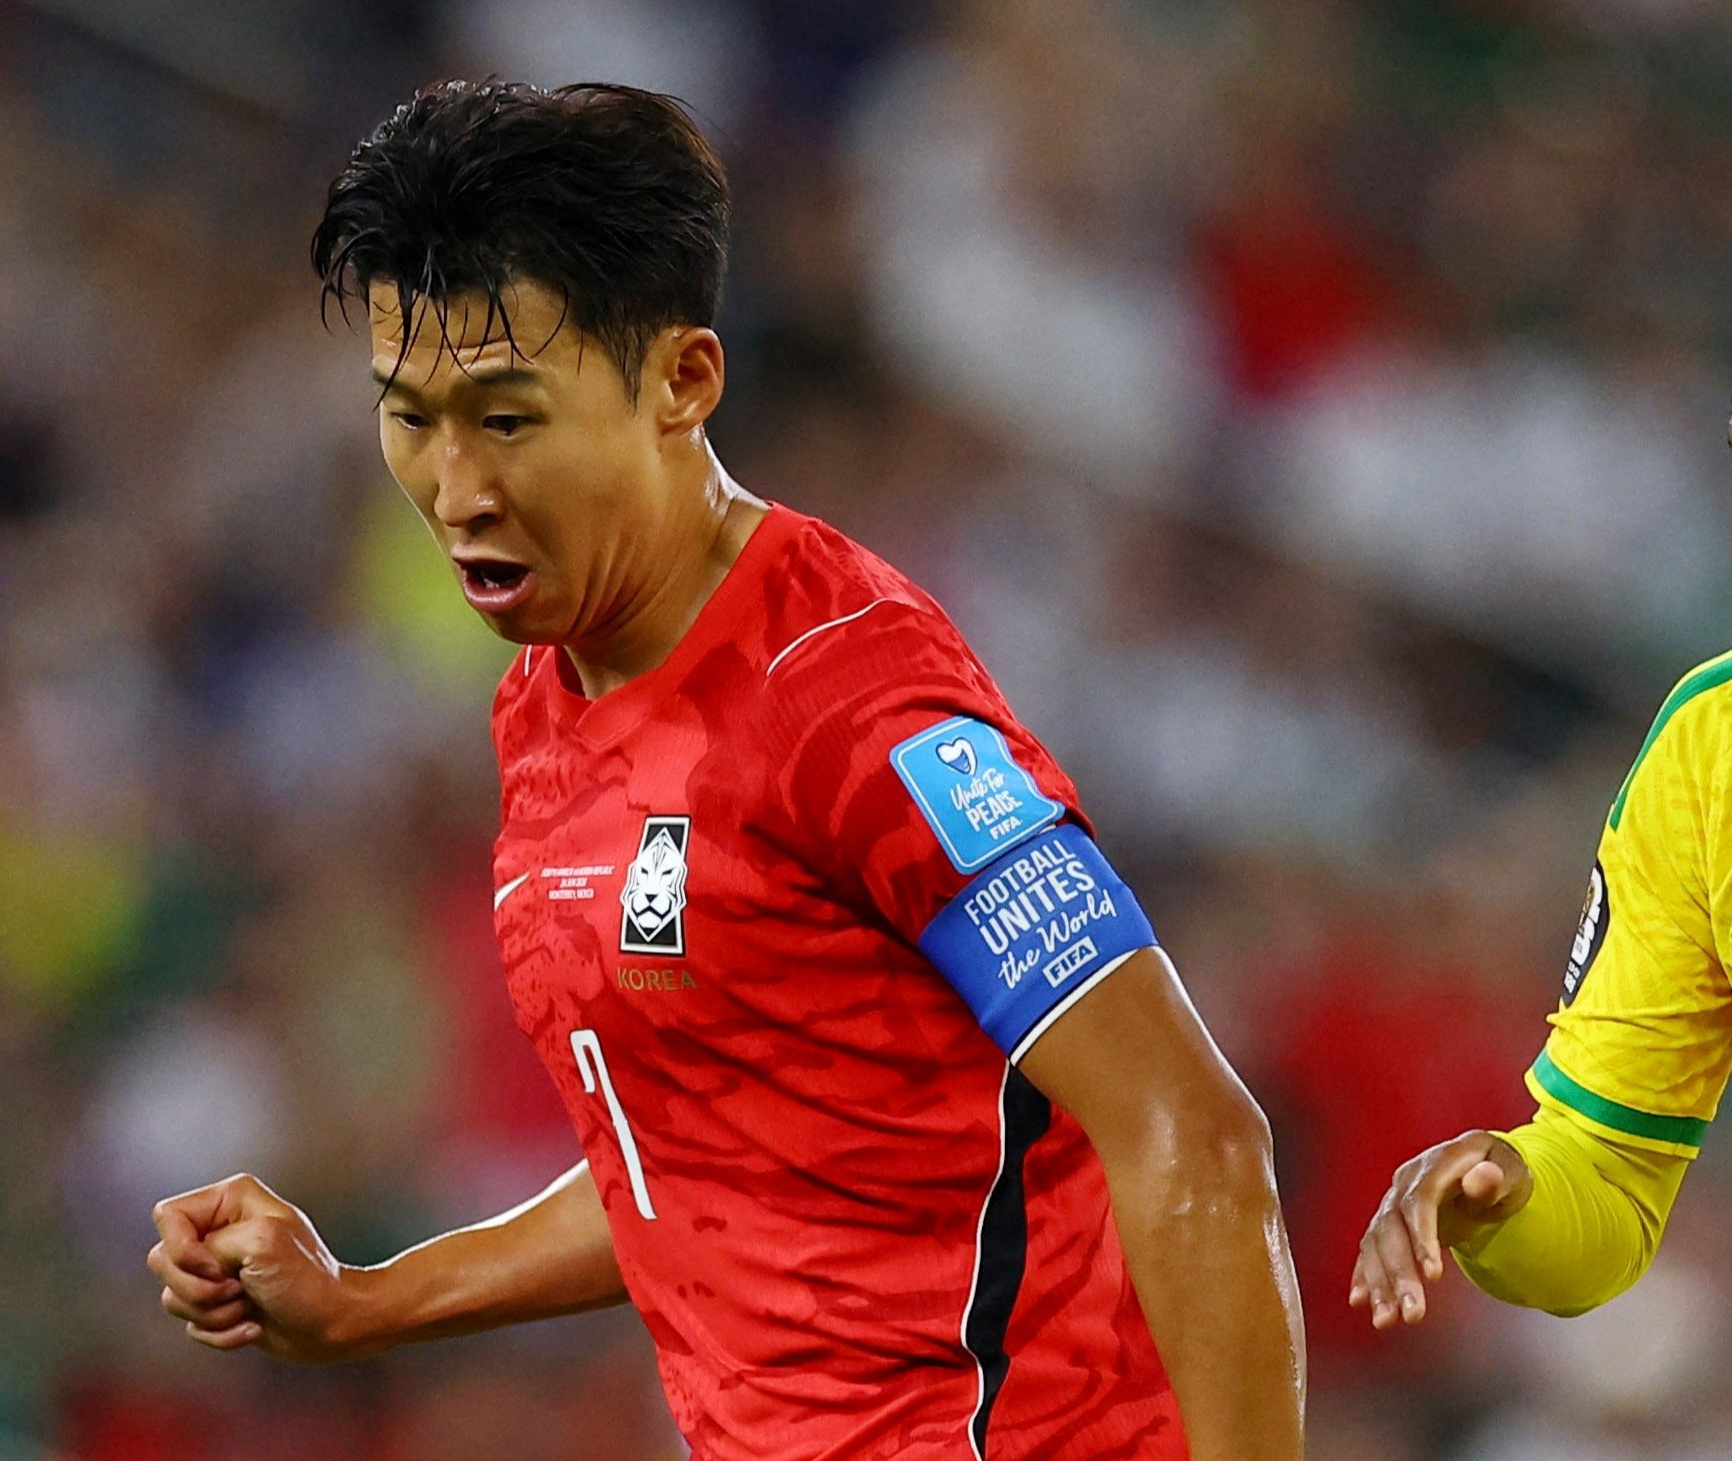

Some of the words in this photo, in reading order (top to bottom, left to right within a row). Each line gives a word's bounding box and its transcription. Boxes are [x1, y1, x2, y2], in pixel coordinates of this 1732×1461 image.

[950, 778, 988, 811] Unite
[982, 767, 1004, 793] For
[965, 790, 1023, 832] PEACE
[989, 815, 1022, 840] FIFA
[964, 838, 1077, 926] FOOTBALL
[979, 861, 1096, 957] UNITES
[997, 948, 1041, 990] the
[1036, 890, 1117, 952] World
[1048, 941, 1093, 982] FIFA
[616, 966, 697, 991] KOREA
[570, 1029, 658, 1220] 7
